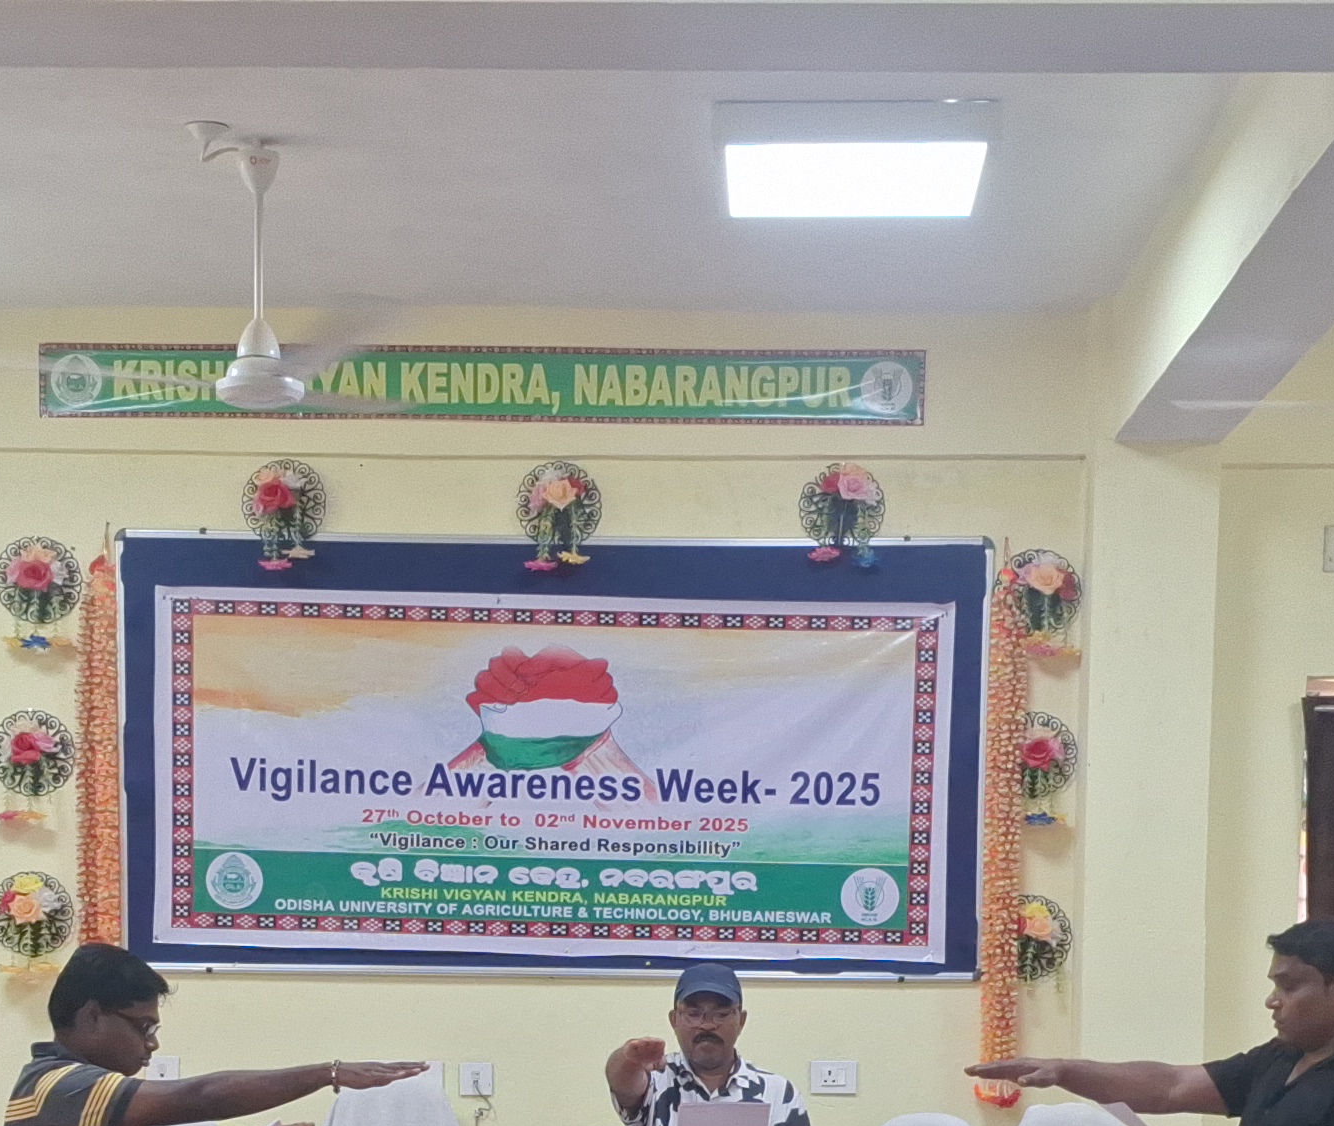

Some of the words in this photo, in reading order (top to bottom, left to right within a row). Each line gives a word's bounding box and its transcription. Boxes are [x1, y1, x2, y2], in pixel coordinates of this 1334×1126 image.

[113, 359, 233, 401] KRISH
[401, 362, 560, 415] KENDRA,
[573, 364, 852, 408] NABARANGPUR
[230, 756, 413, 802] Vigilance
[424, 762, 642, 802] Awareness
[655, 768, 777, 804] Week-
[789, 771, 881, 806] 2025
[362, 808, 400, 823] 27th
[406, 809, 493, 826] October
[500, 813, 521, 827] to
[534, 813, 575, 828] 02nd
[583, 814, 692, 831] November
[698, 817, 749, 832] 2025
[370, 832, 466, 850] “Vigilance
[472, 838, 478, 849] :
[484, 835, 519, 850] Our
[524, 836, 590, 851] Shared
[597, 838, 741, 858] Responsibility”
[381, 887, 438, 900] KRISHI
[443, 889, 506, 902] VIGYAN
[512, 890, 588, 905] KENDRA,
[594, 892, 727, 906] NABARANGPUR
[274, 898, 335, 911] ODISHA
[339, 900, 432, 914] UNIVERSITY
[436, 902, 458, 915] OF
[462, 903, 573, 918] AGRICULTURE
[578, 907, 589, 918] &
[593, 907, 704, 922] TECHNOLOGY,
[709, 909, 832, 924] BHUBANESWAR
